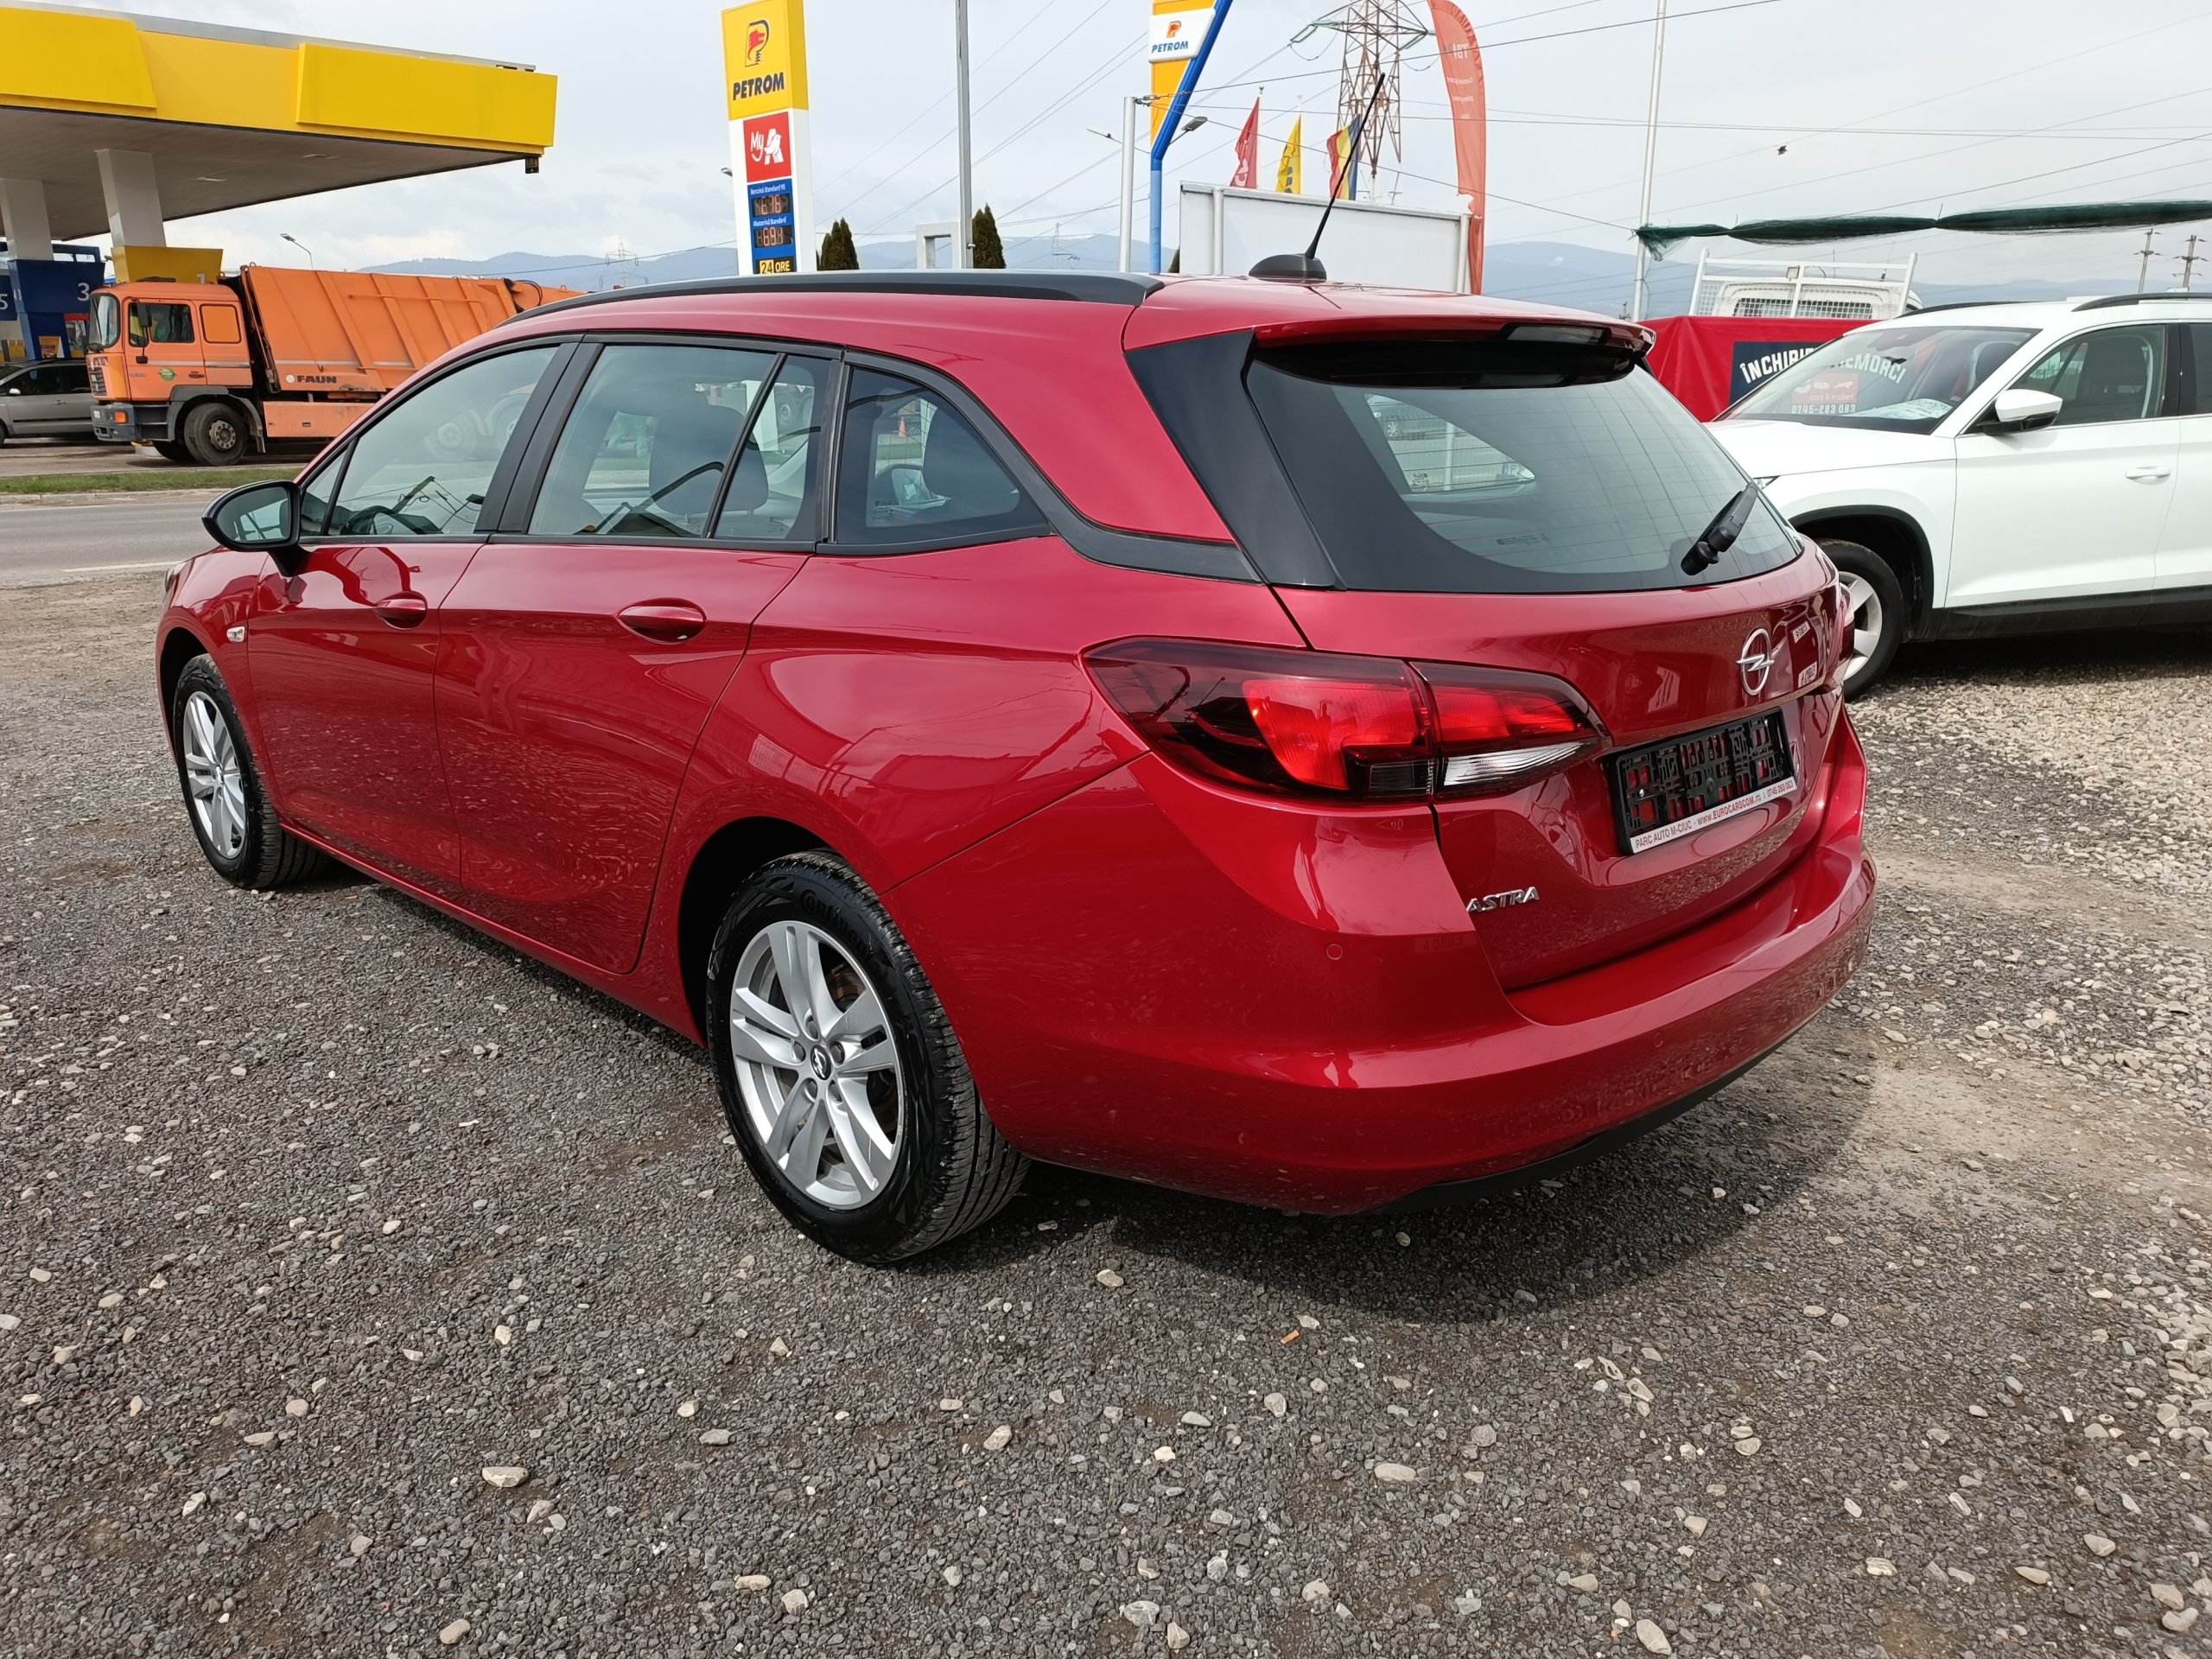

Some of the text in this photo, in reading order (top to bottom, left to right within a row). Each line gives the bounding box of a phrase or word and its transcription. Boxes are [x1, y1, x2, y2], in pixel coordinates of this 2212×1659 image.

[1151, 41, 1189, 54] PETROM
[733, 72, 785, 101] PETROM
[761, 261, 791, 274] 24 ORE
[77, 282, 90, 302] 3
[0, 293, 9, 310] 5
[296, 375, 337, 384] FAUN
[1791, 404, 1856, 415] 0745-283 083
[1635, 835, 1653, 849] PARC
[1653, 828, 1670, 844] AUTO
[1670, 820, 1693, 836] M-CIUC
[1696, 794, 1762, 826] www.EUROCARSCOM.ro
[1465, 886, 1540, 912] ASTRA
